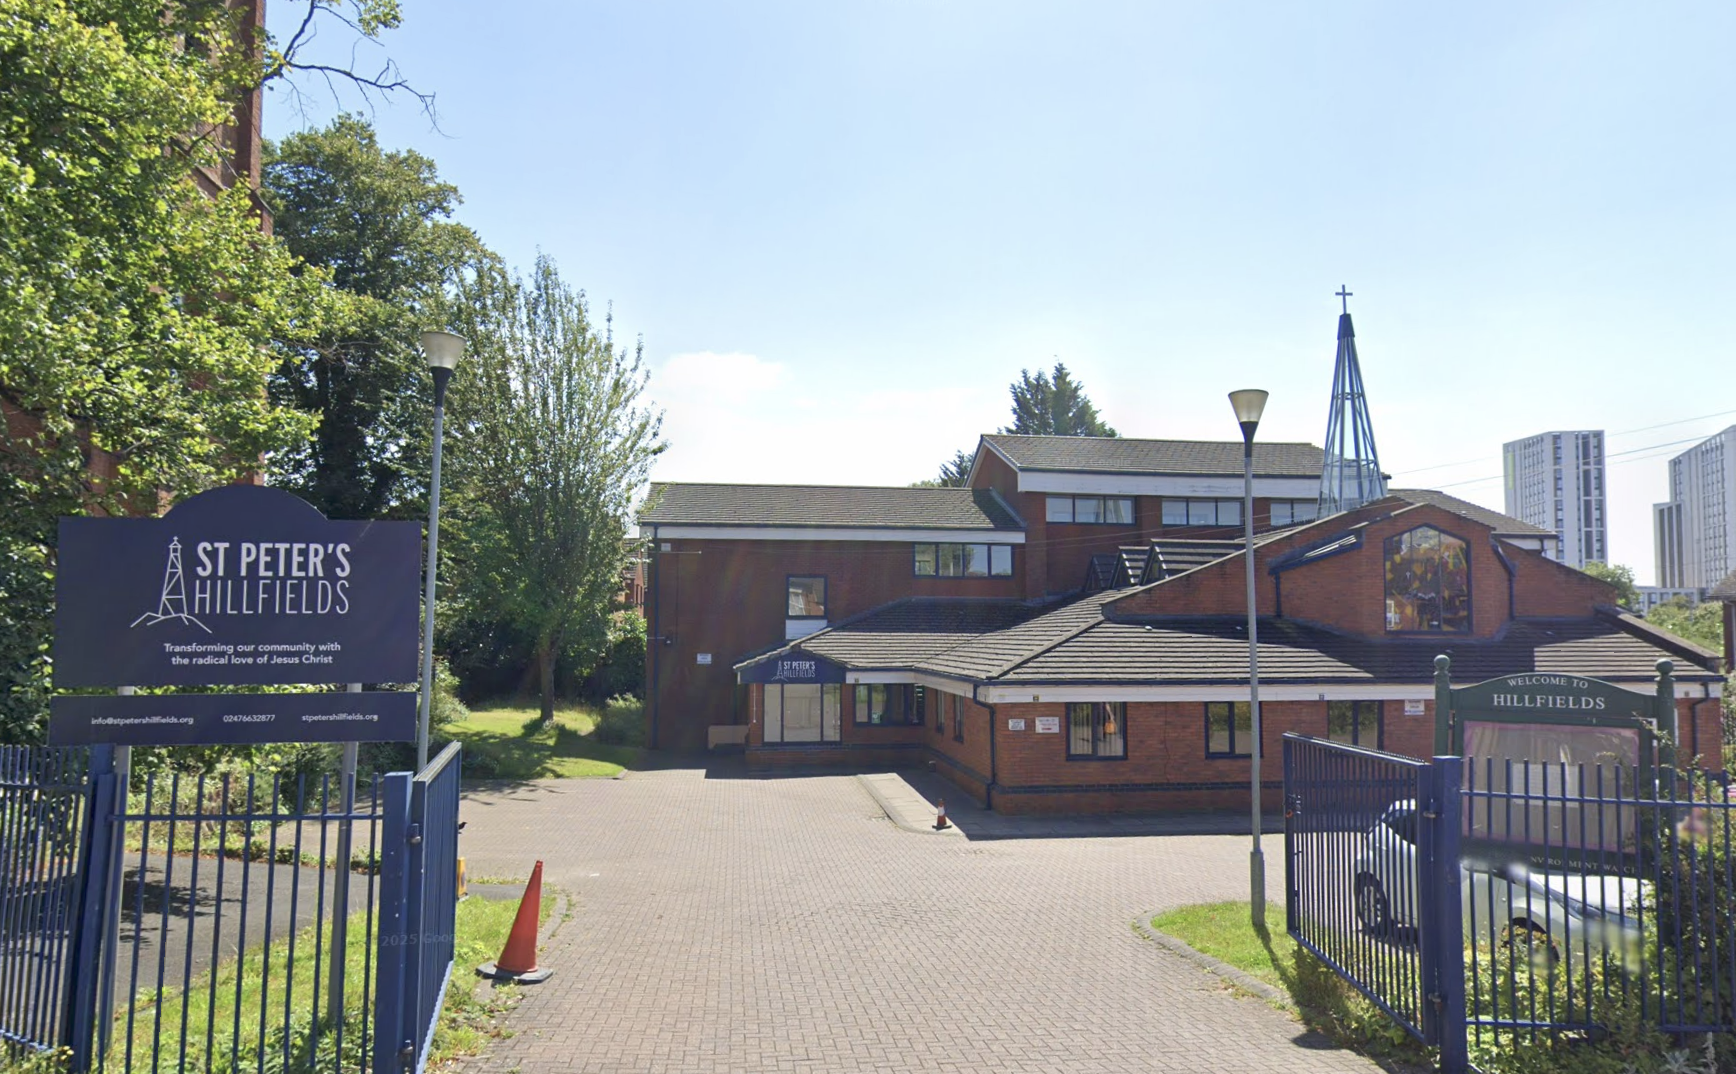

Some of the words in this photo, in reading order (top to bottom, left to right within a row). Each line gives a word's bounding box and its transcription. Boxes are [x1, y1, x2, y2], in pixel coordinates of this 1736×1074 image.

[196, 541, 230, 577] ST
[240, 542, 351, 577] PETER'S
[194, 579, 349, 614] HILLFIELDS
[164, 643, 234, 654] Transforming
[237, 644, 255, 652] our
[258, 642, 316, 654] community
[318, 642, 341, 652] with
[171, 655, 189, 665] the
[192, 655, 228, 665] radical
[231, 655, 253, 664] love
[256, 654, 268, 664] of
[270, 655, 299, 665] Jesus
[302, 654, 333, 664] Christ
[784, 661, 790, 670] ST
[792, 661, 815, 670] PETER'S
[784, 670, 815, 678] HILLFIELDS
[1507, 676, 1568, 687] WELCOME
[1572, 678, 1589, 689] TO
[1493, 693, 1606, 710] HILLFIELDS
[91, 716, 194, 727] info@stpetershillfields.org
[223, 714, 276, 723] 02476632877
[301, 713, 379, 723] stpetershillfields.org
